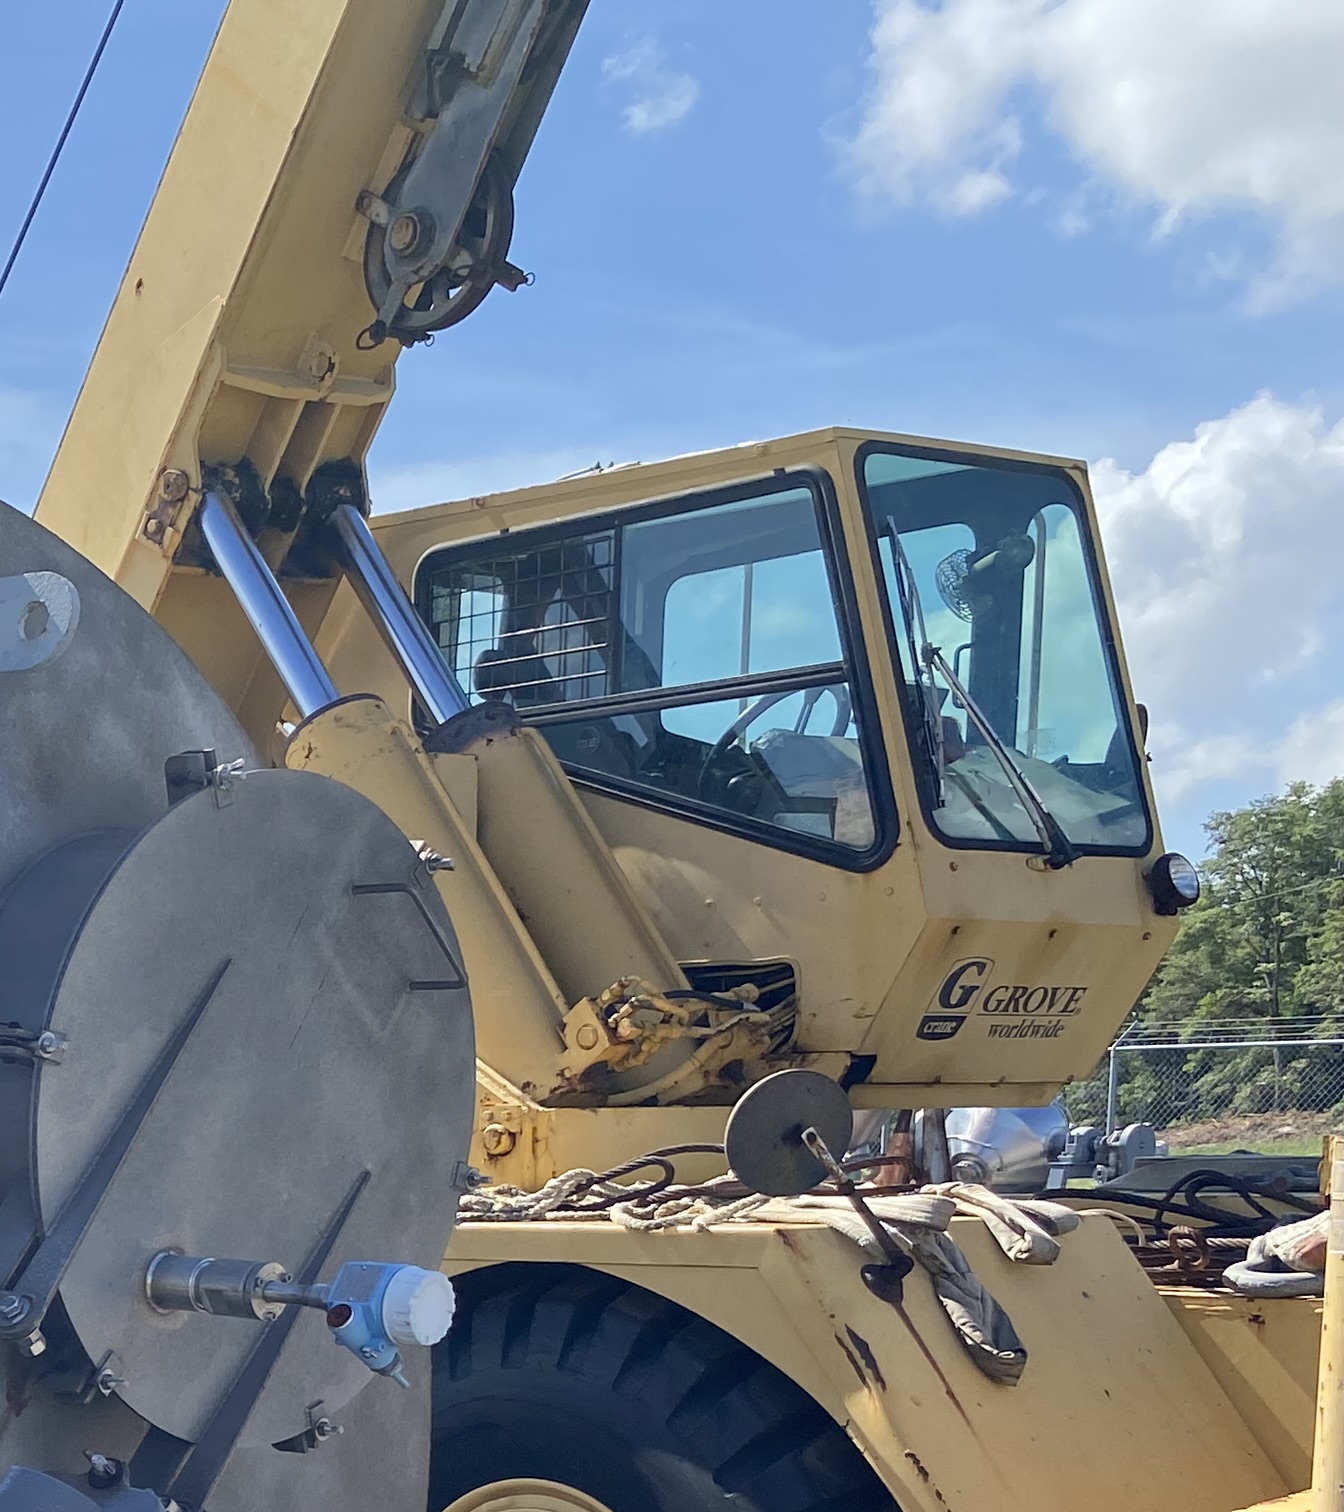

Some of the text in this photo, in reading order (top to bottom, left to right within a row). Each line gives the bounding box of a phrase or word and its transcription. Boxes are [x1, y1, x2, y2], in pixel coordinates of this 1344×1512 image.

[939, 961, 988, 1010] G
[982, 986, 1088, 1014] GROVE
[987, 1018, 1065, 1039] worldwide
